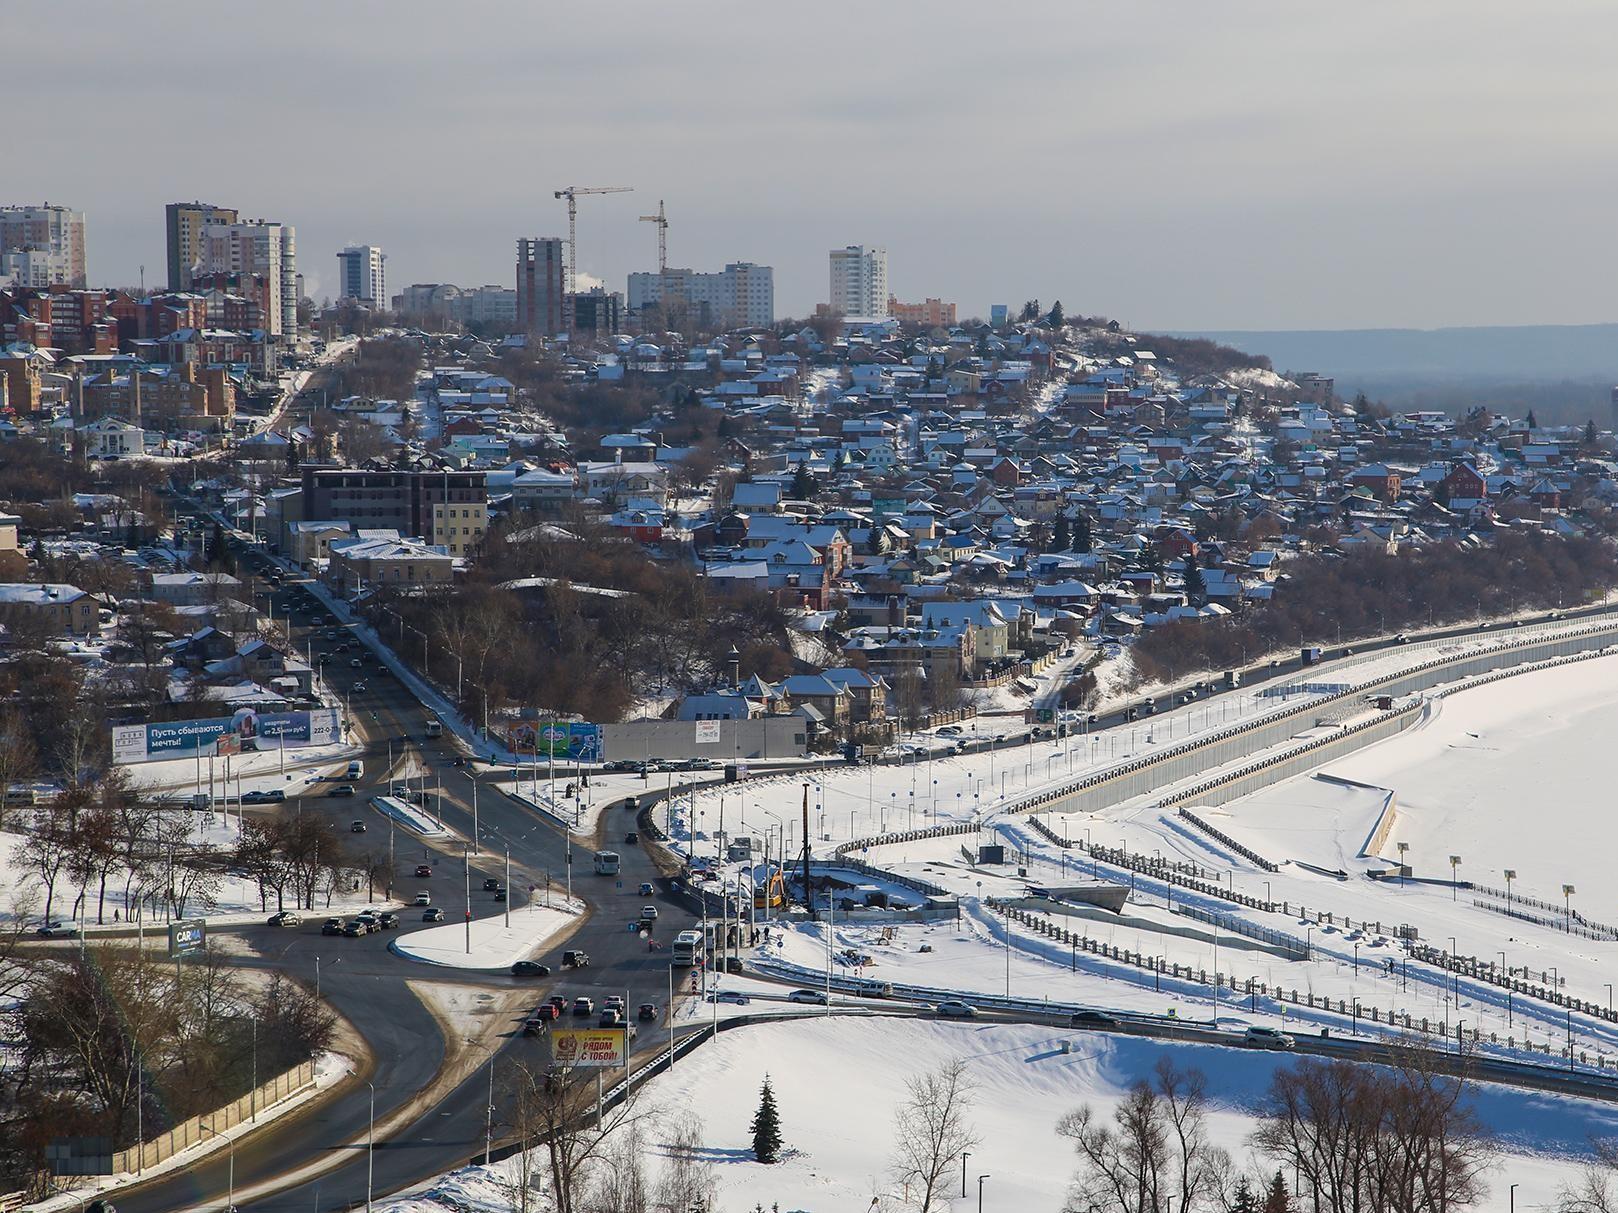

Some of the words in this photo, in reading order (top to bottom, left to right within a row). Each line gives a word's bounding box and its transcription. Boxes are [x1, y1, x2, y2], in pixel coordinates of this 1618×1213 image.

[151, 729, 176, 738] Пусть
[177, 725, 224, 735] сбываются
[151, 738, 182, 747] мечты!
[583, 1041, 613, 1051] РЯДОМ
[581, 1052, 587, 1060] С
[589, 1051, 618, 1061] ТОБОЙ!
